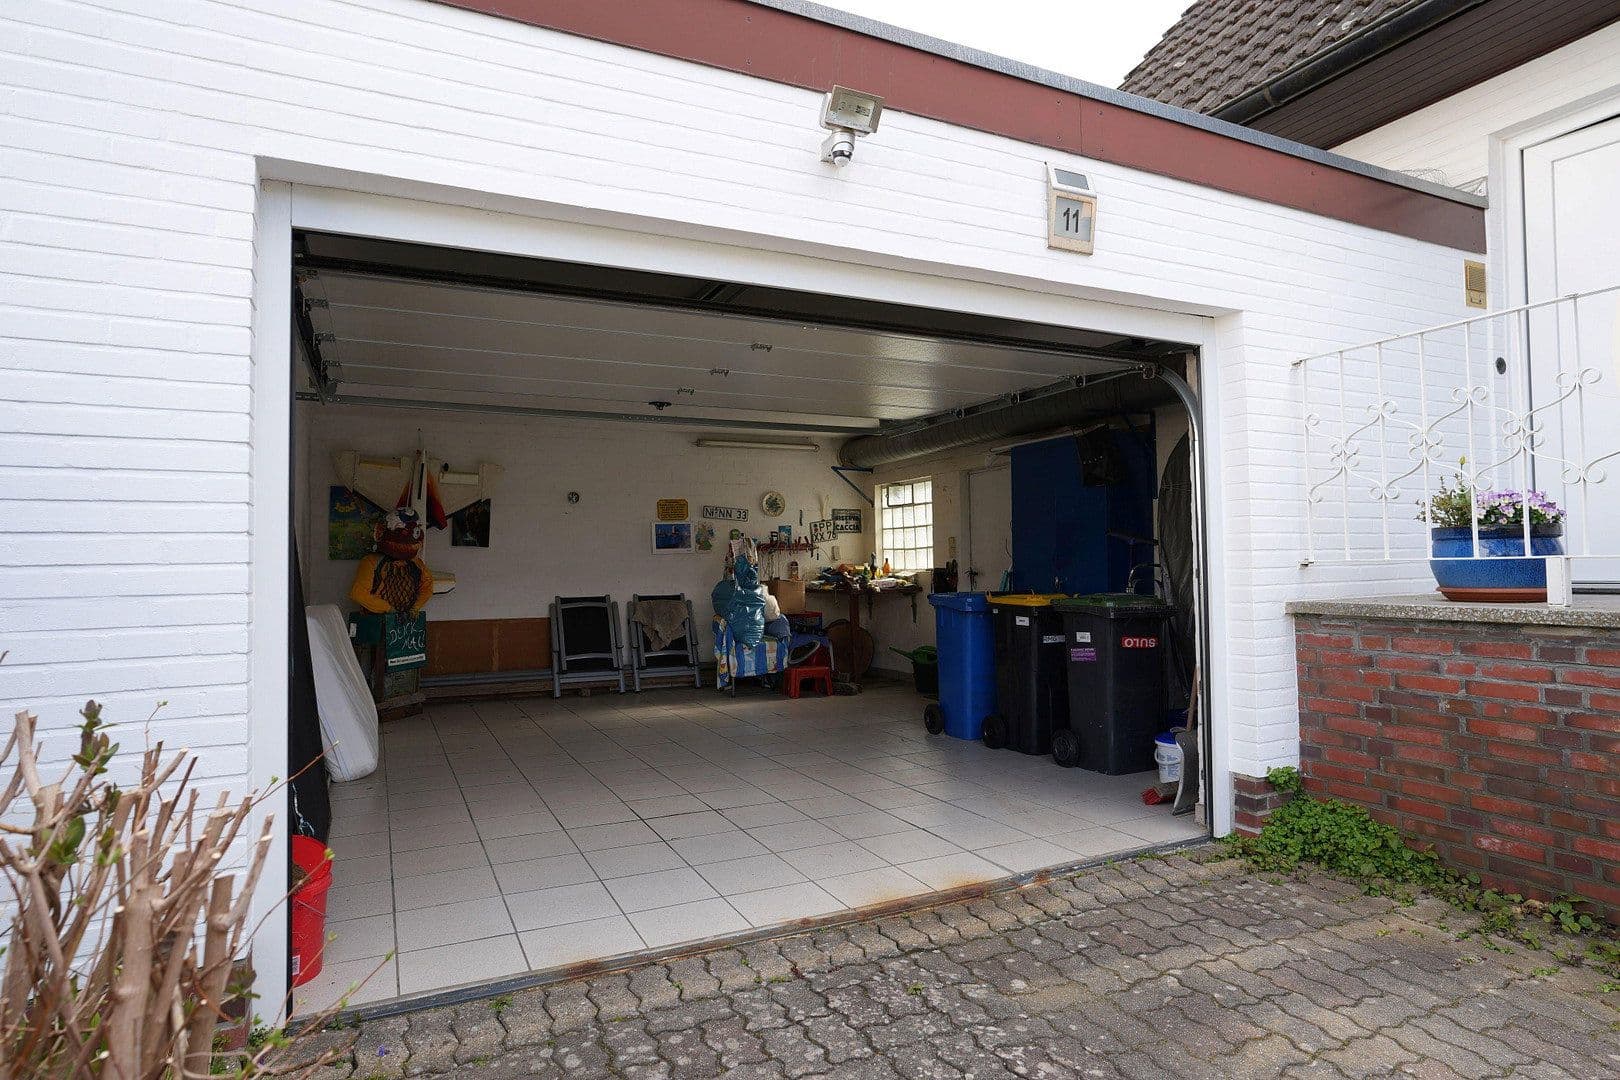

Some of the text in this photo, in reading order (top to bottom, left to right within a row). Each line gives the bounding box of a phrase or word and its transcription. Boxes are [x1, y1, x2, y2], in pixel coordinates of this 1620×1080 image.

[1063, 207, 1080, 233] 11
[736, 510, 747, 520] 33
[1124, 638, 1156, 648] SULO
